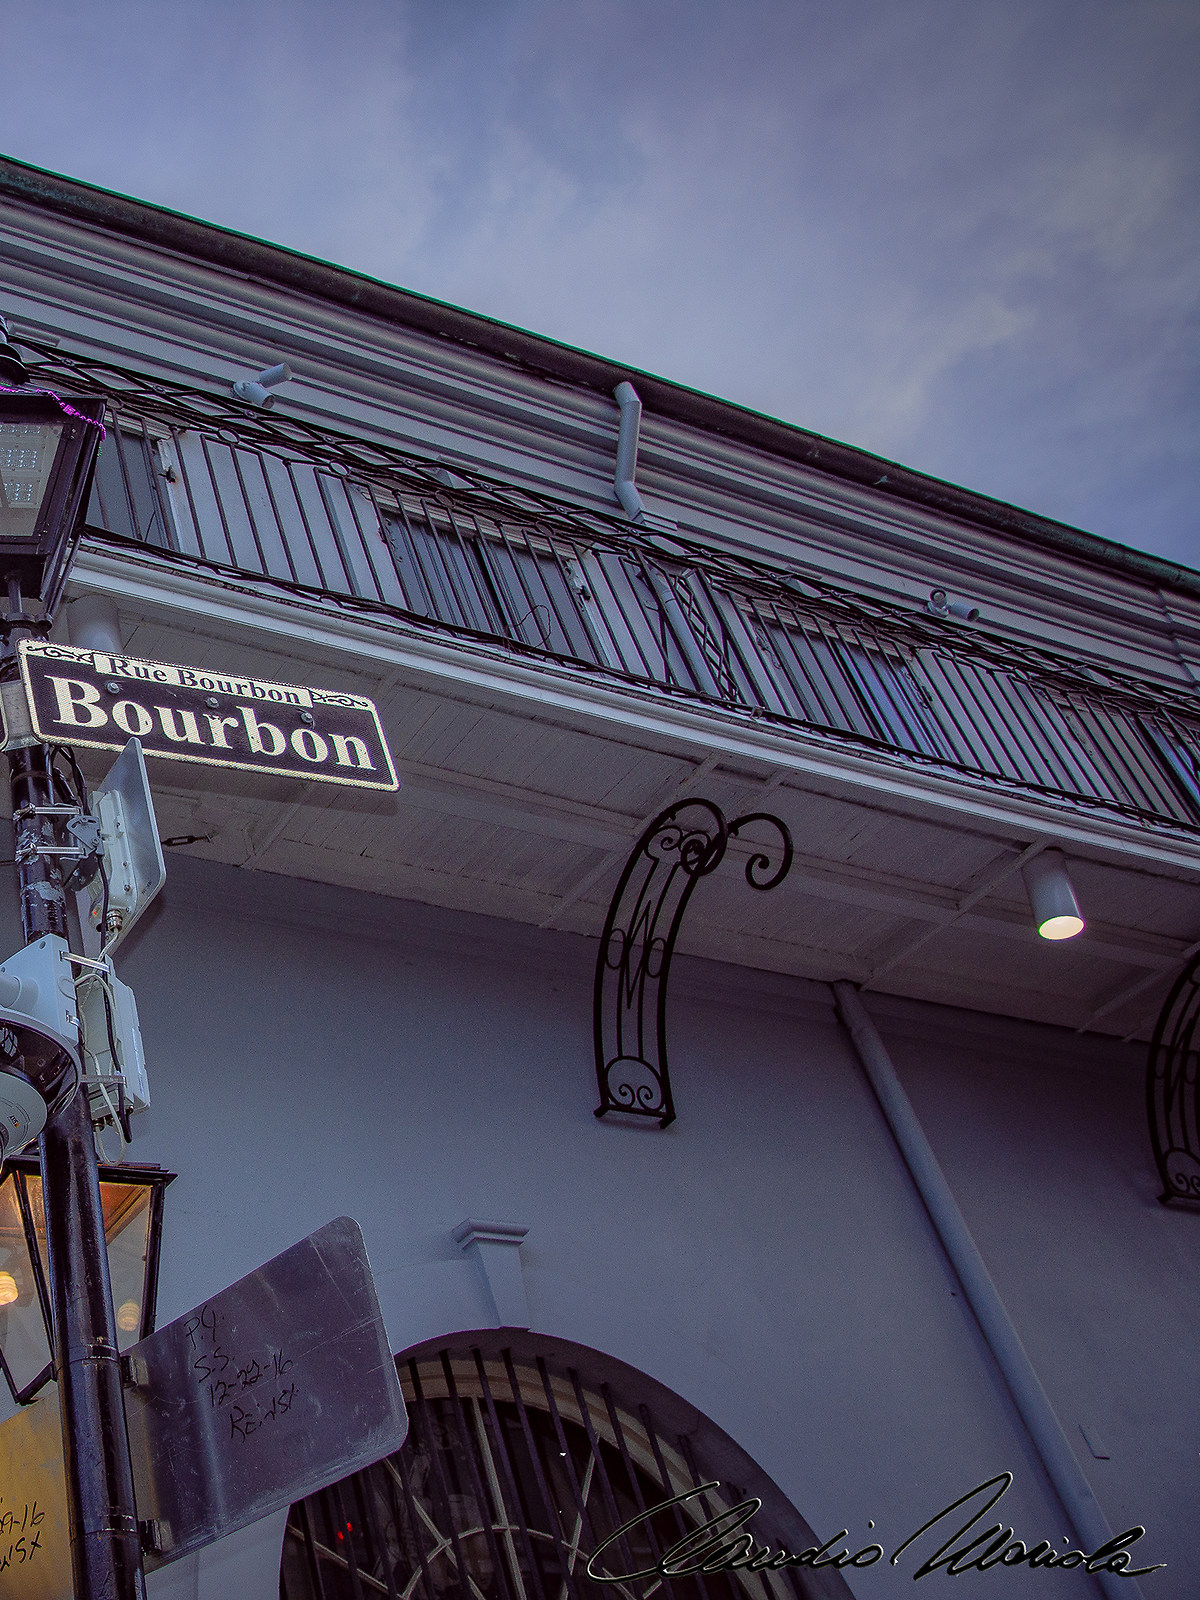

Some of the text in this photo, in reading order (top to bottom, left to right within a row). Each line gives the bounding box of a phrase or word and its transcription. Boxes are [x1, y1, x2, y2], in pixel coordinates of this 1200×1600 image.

[108, 659, 301, 705] Rue Bourbon
[44, 675, 377, 772] Bourbon
